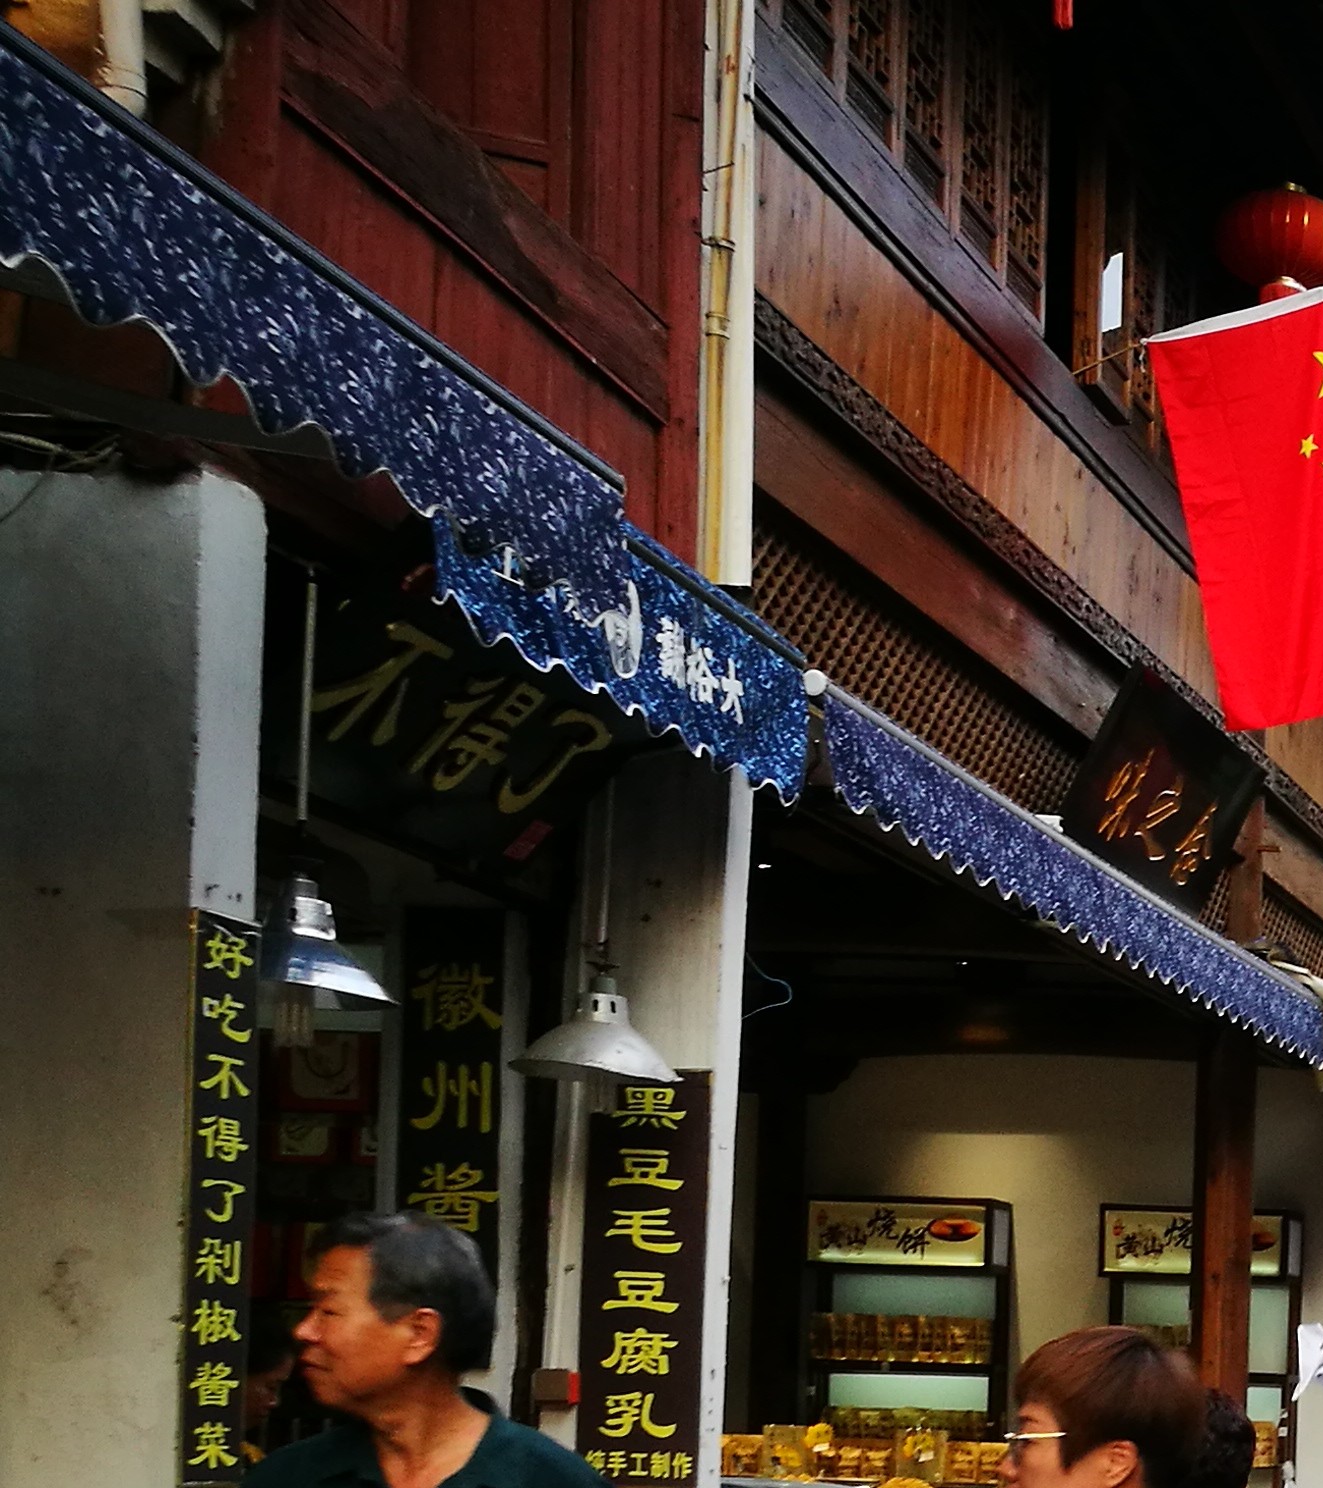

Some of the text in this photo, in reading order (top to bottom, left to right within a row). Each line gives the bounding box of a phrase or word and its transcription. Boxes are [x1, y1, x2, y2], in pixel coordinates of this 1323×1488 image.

[187, 933, 255, 1471] 好吃不得了剁椒酱菜
[599, 1086, 687, 1439] 黑豆毛豆腐乳
